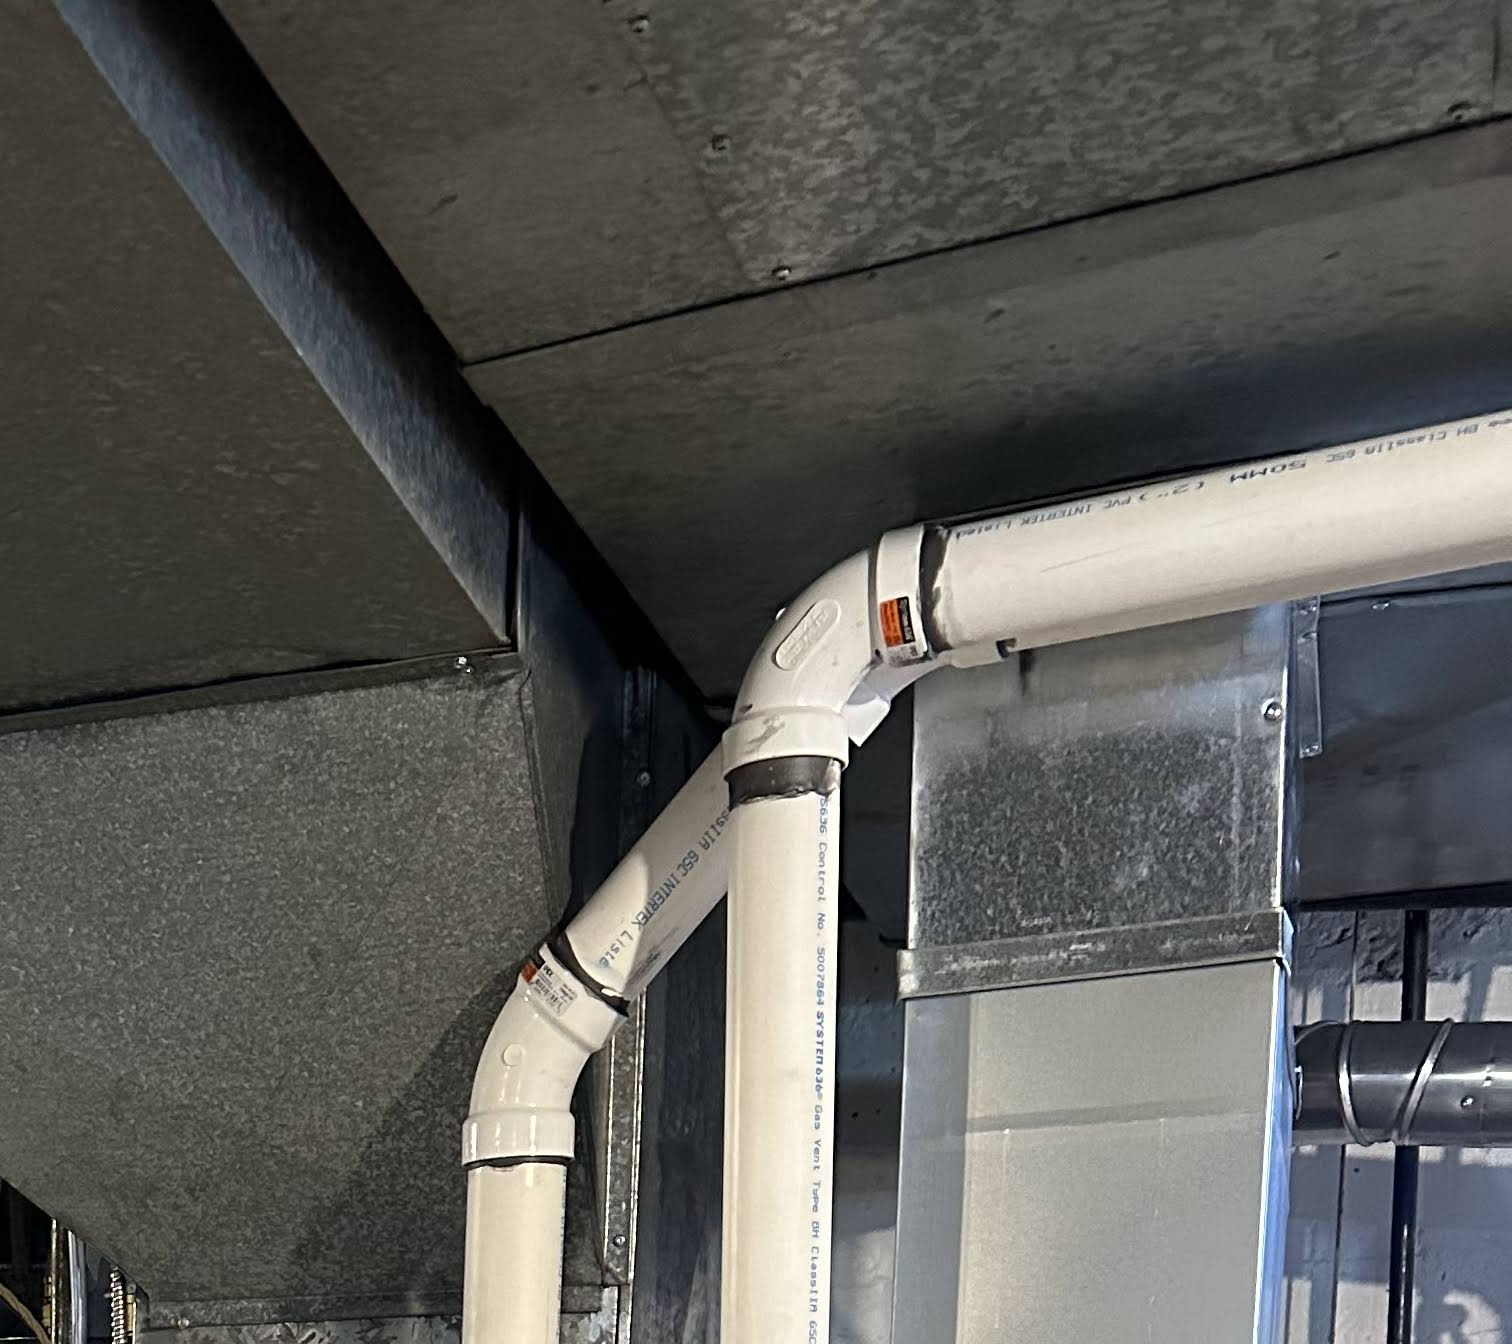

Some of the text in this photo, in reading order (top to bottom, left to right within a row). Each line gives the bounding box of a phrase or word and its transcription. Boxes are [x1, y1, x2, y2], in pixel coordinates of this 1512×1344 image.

[1227, 458, 1306, 484] 50MM
[1020, 504, 1092, 526] INTERTEK
[818, 842, 827, 901] Control
[632, 874, 680, 929] INTERTEK
[817, 913, 826, 936] No.
[599, 931, 632, 969] Liste
[816, 947, 825, 1005] 5007864
[814, 1105, 823, 1130] Gas
[813, 1140, 822, 1170] Vent
[811, 1181, 821, 1213] Type
[812, 1221, 819, 1238] BH
